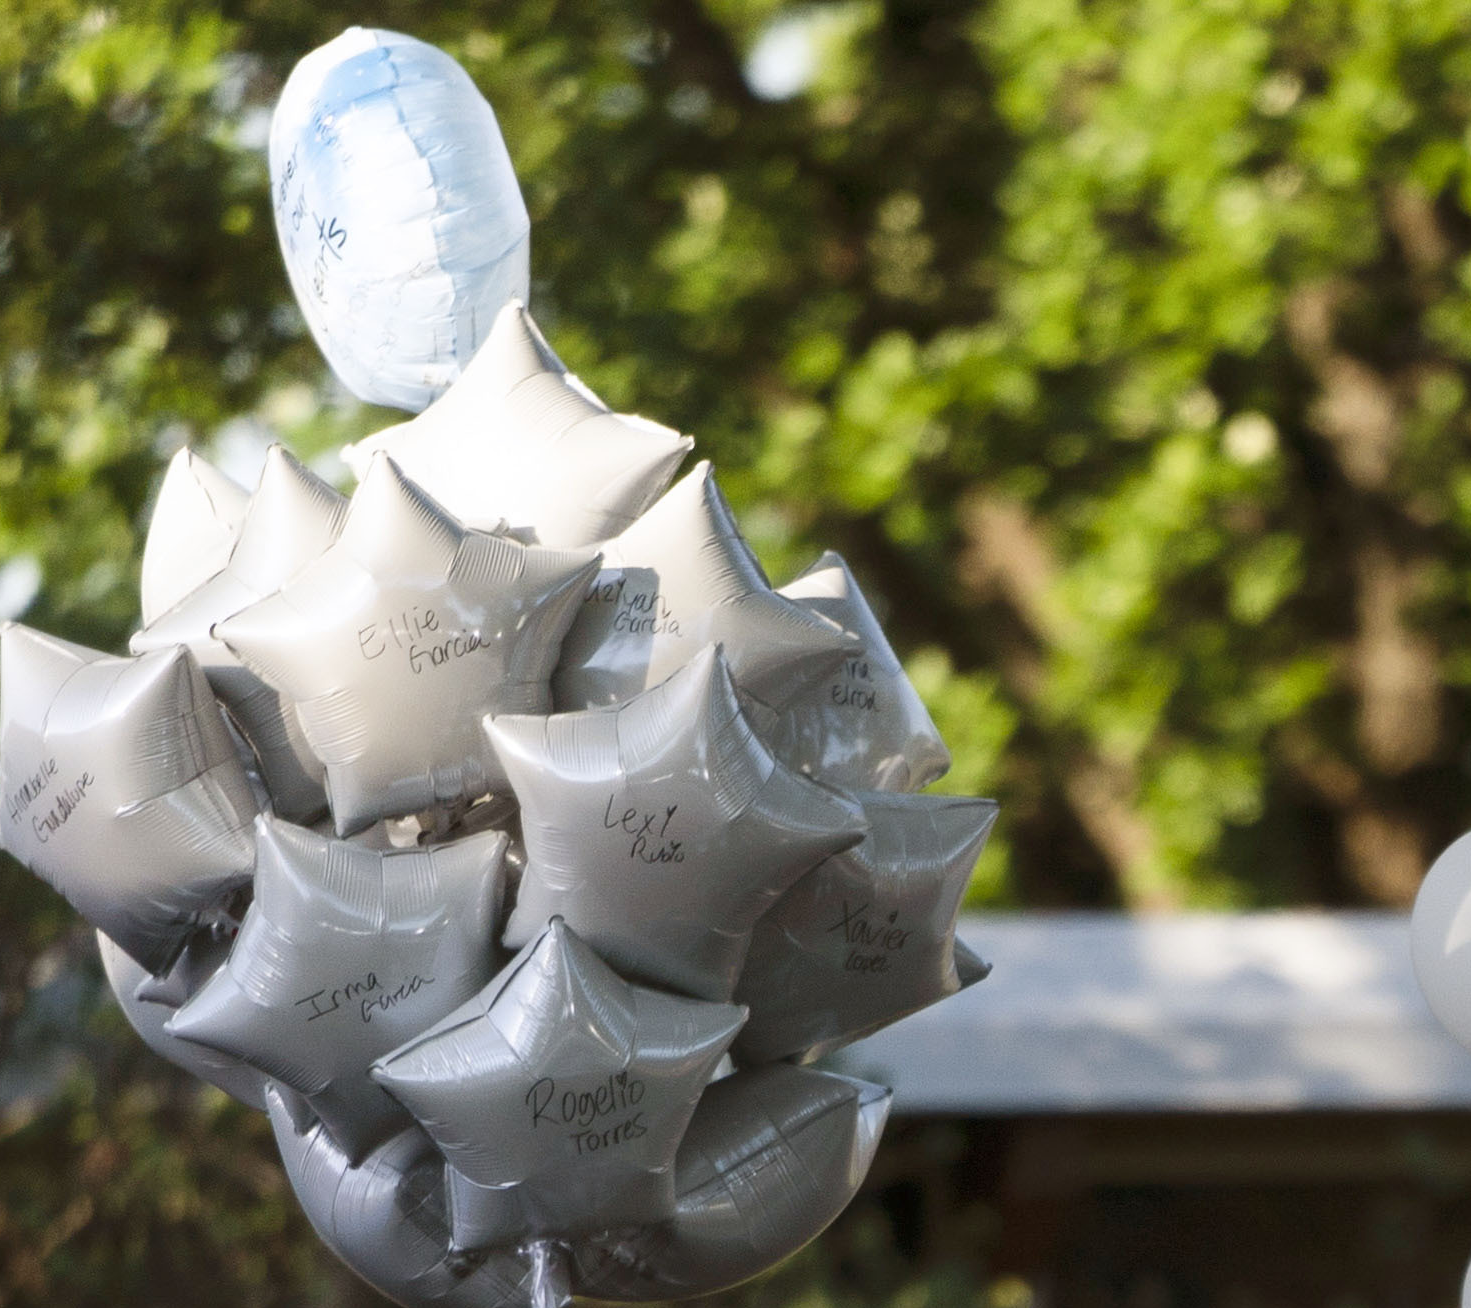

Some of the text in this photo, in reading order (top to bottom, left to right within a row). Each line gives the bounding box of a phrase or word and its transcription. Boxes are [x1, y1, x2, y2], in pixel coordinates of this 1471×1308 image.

[358, 606, 439, 660] Ellie
[614, 611, 683, 637] Garcia
[409, 630, 490, 674] Garcia
[825, 900, 915, 951] Xavier
[295, 972, 381, 1022] Irma
[361, 973, 435, 1024] Garcia
[526, 1070, 645, 1129] Rogelio
[571, 1113, 648, 1156] Torres
